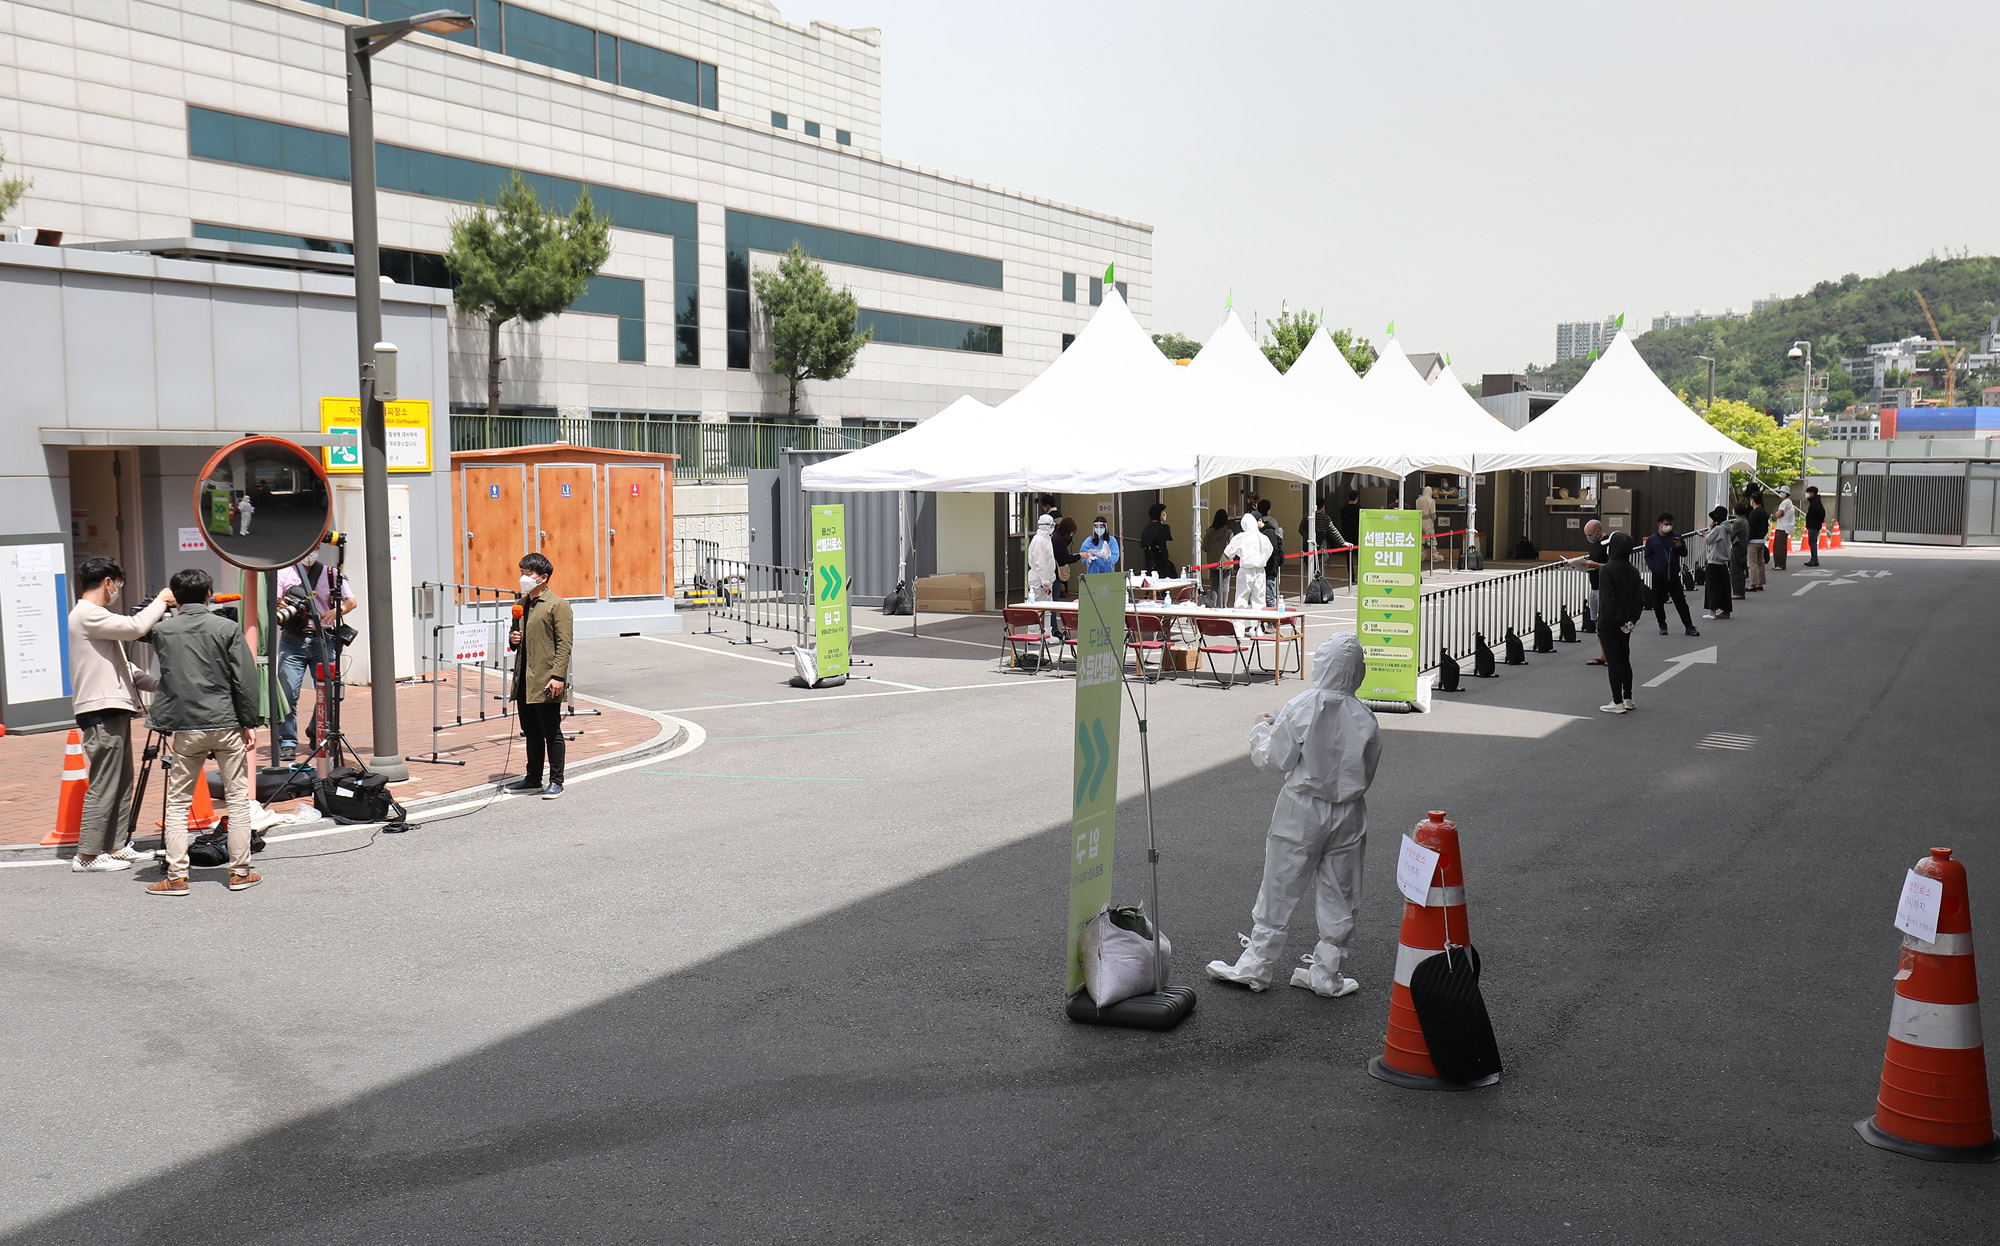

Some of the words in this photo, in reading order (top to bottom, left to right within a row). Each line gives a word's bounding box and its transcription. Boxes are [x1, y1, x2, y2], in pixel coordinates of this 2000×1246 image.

[822, 526, 836, 537] 용산구
[816, 537, 844, 552] 선별진료소
[1364, 531, 1416, 548] 선별진료소
[1374, 550, 1404, 567] 안내
[1364, 599, 1369, 607] 2
[824, 610, 842, 626] 입구
[1363, 623, 1369, 631] 3
